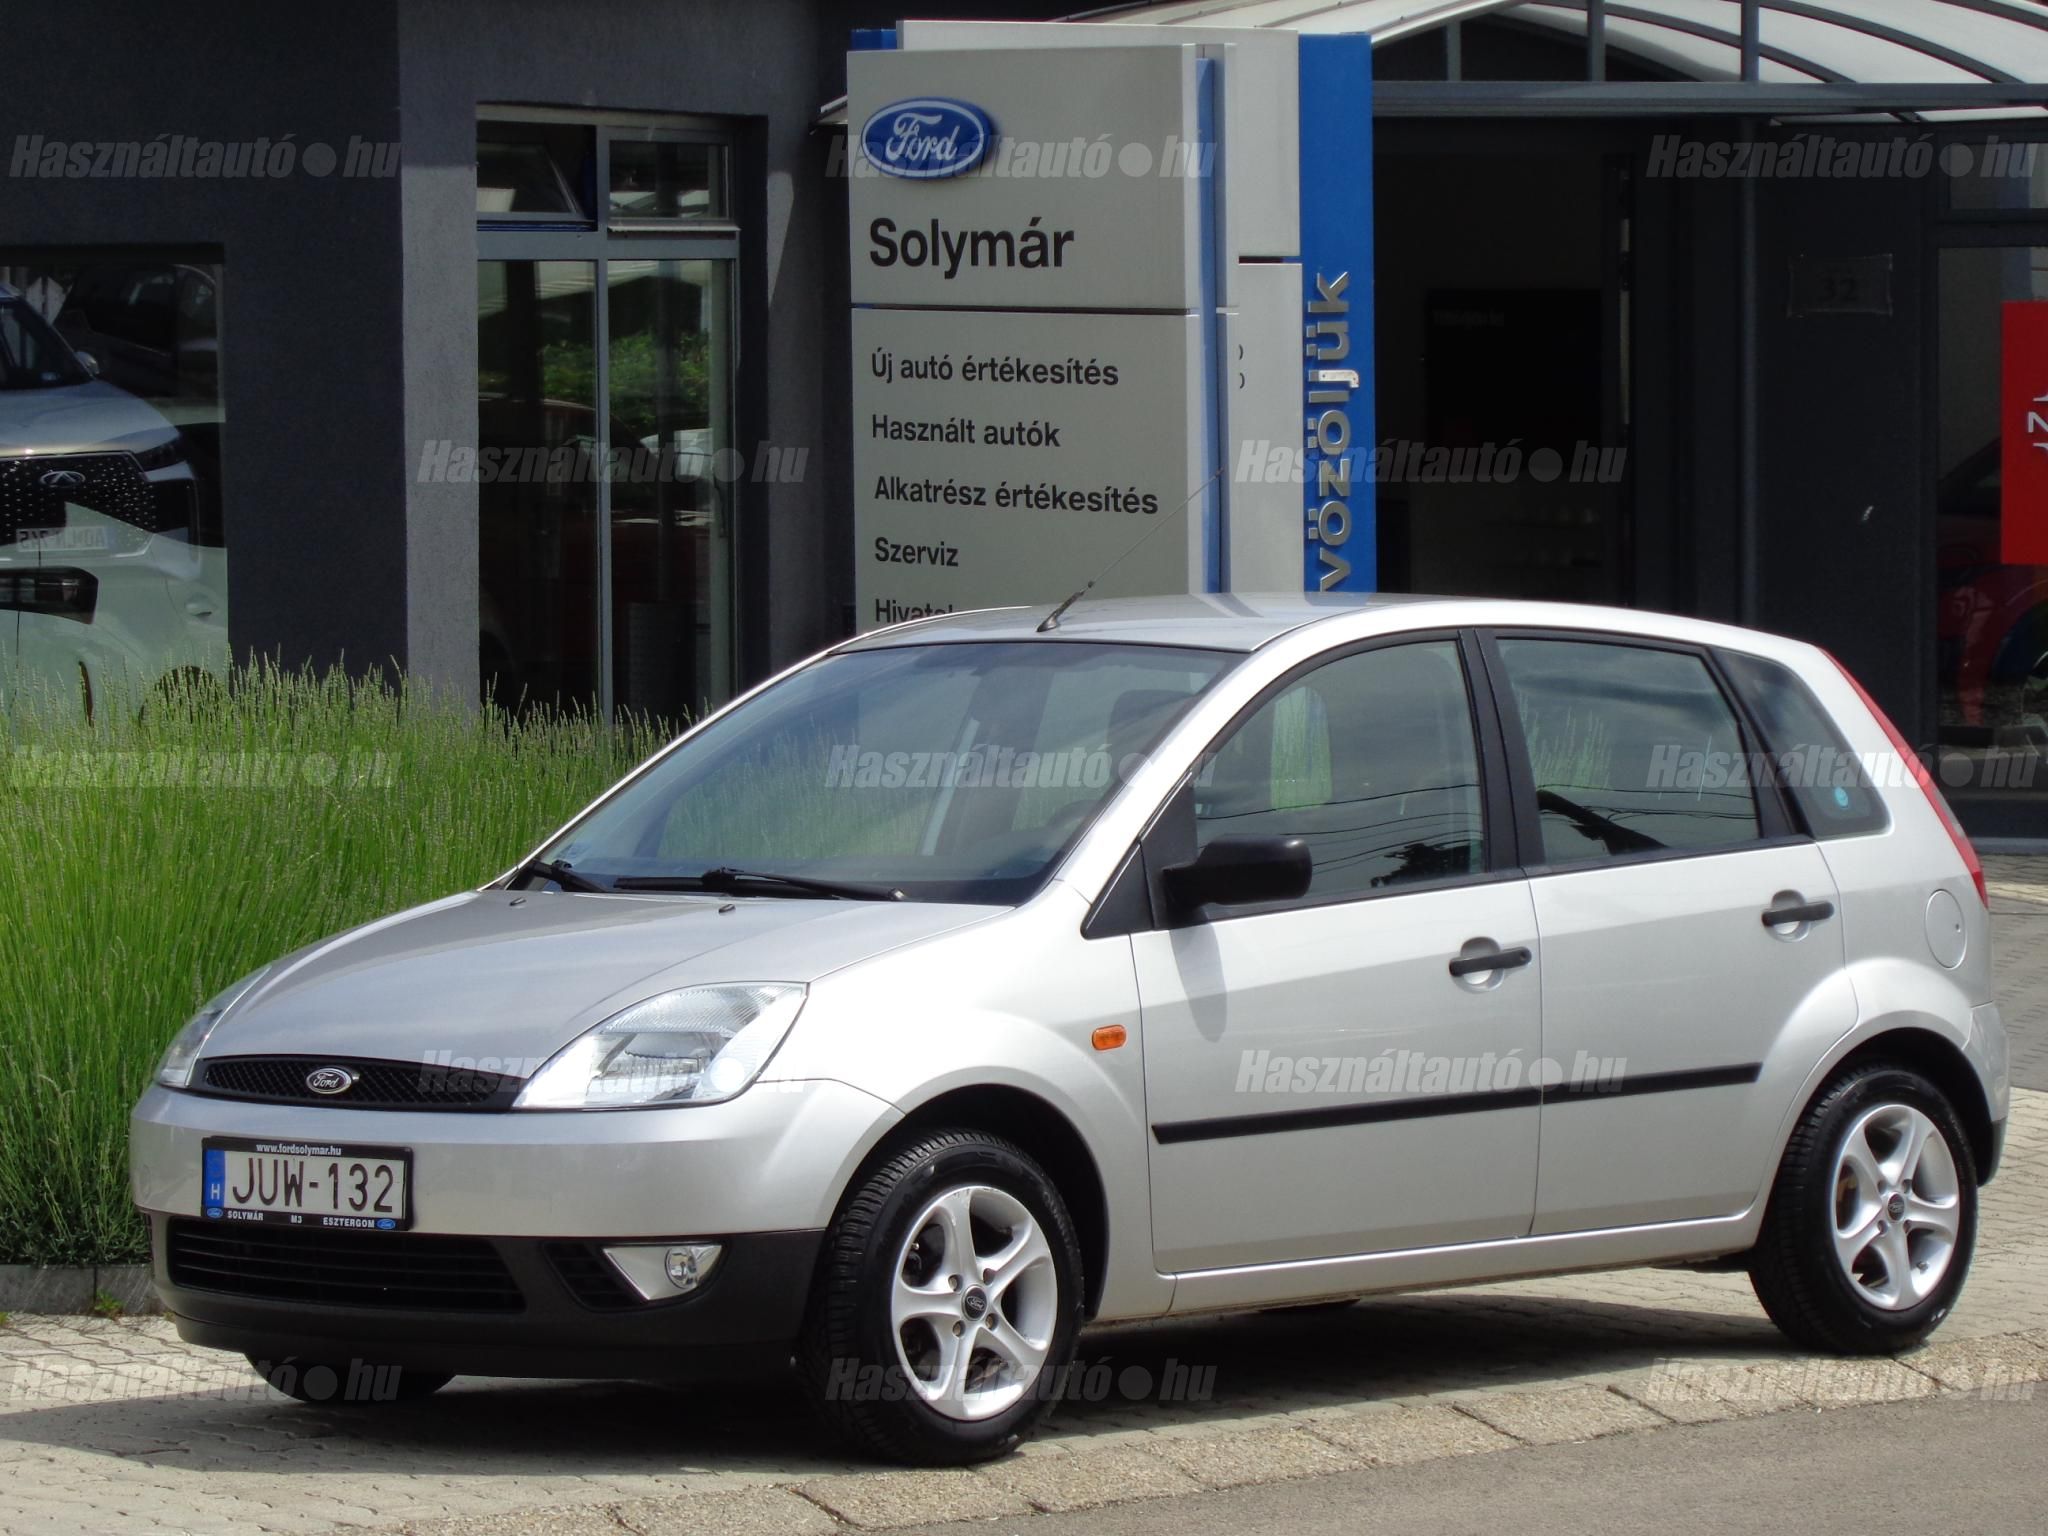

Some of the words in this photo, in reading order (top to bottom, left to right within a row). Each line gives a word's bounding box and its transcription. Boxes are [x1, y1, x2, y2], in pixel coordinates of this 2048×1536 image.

[884, 112, 958, 161] Ford
[869, 216, 1075, 280] Solymár
[871, 347, 893, 384] Új
[900, 354, 953, 381] autó
[961, 355, 1119, 386] értékesítés
[871, 413, 976, 444] Használt
[983, 420, 1061, 448] autók
[874, 475, 987, 507] Alkatrész
[995, 481, 1159, 515] értékesítés
[874, 535, 959, 567] Szerviz
[312, 1072, 340, 1088] Ford
[255, 1143, 342, 1157] www.fordsolymar.hu
[210, 1183, 221, 1200] H
[232, 1157, 394, 1213] JUW-132
[227, 1210, 264, 1221] SOLYMÁR
[290, 1214, 303, 1224] M3
[322, 1216, 375, 1228] ESZTERGOM
